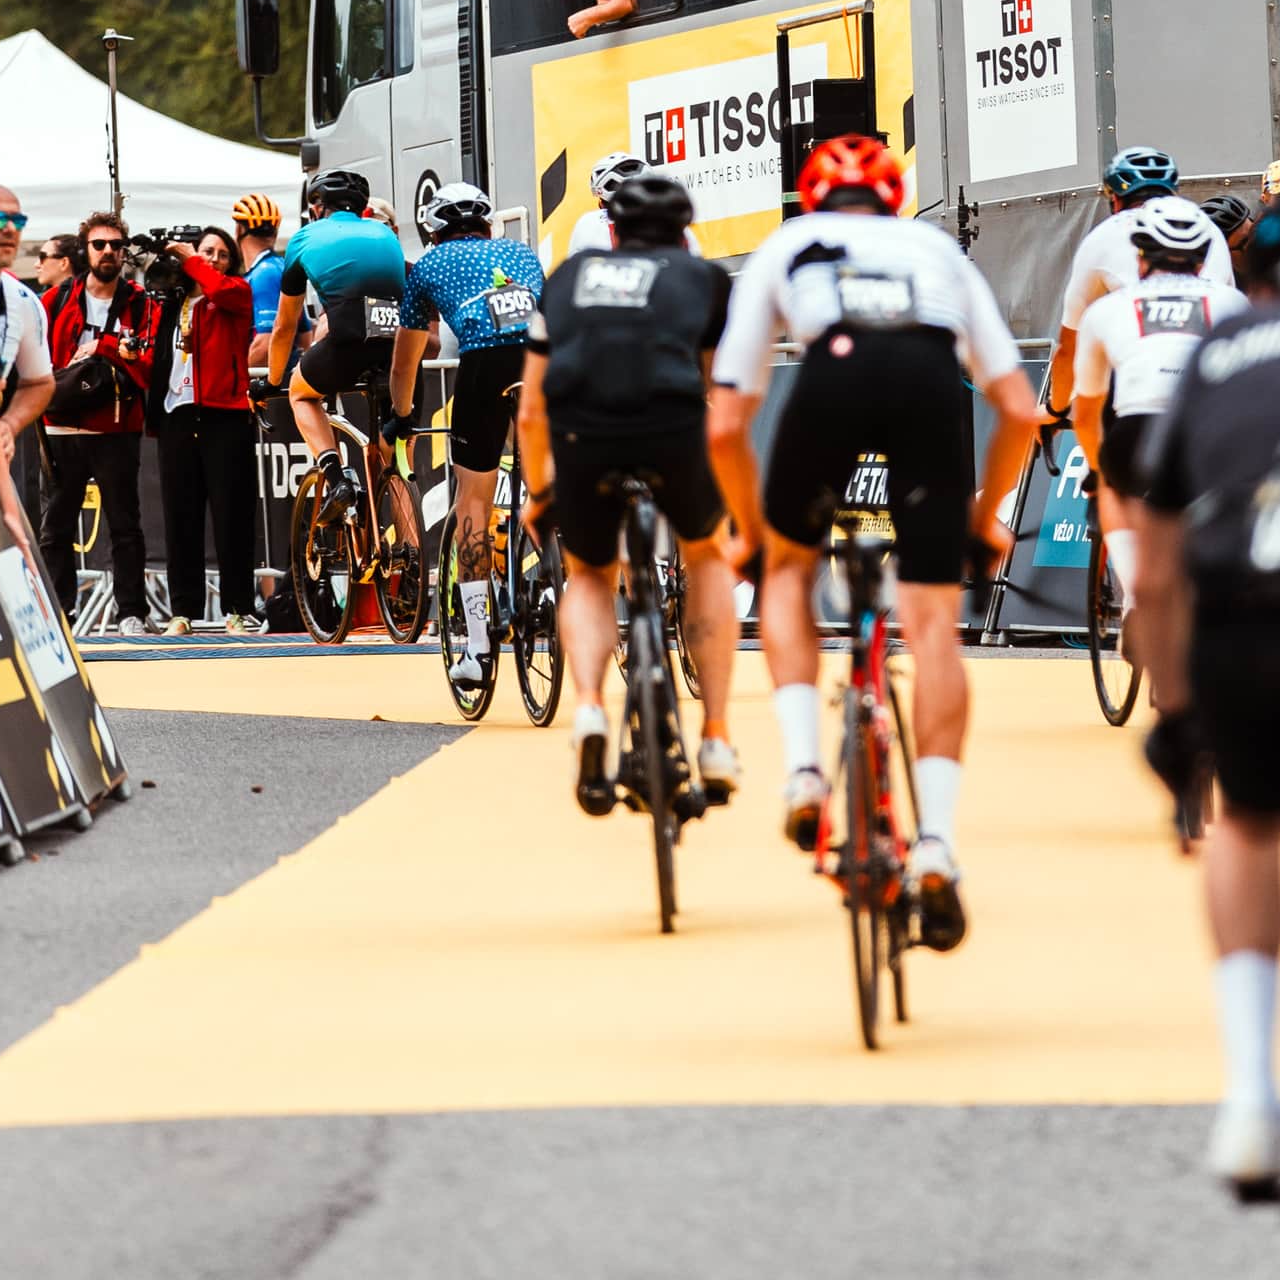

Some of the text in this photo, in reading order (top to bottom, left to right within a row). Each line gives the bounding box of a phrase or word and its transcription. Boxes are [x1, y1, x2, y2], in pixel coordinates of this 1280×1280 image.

[976, 36, 1062, 89] TISSOT
[686, 164, 742, 190] WATCHES
[748, 156, 783, 179] SINCE
[488, 290, 533, 316] 12505
[1053, 520, 1075, 542] VÉLO
